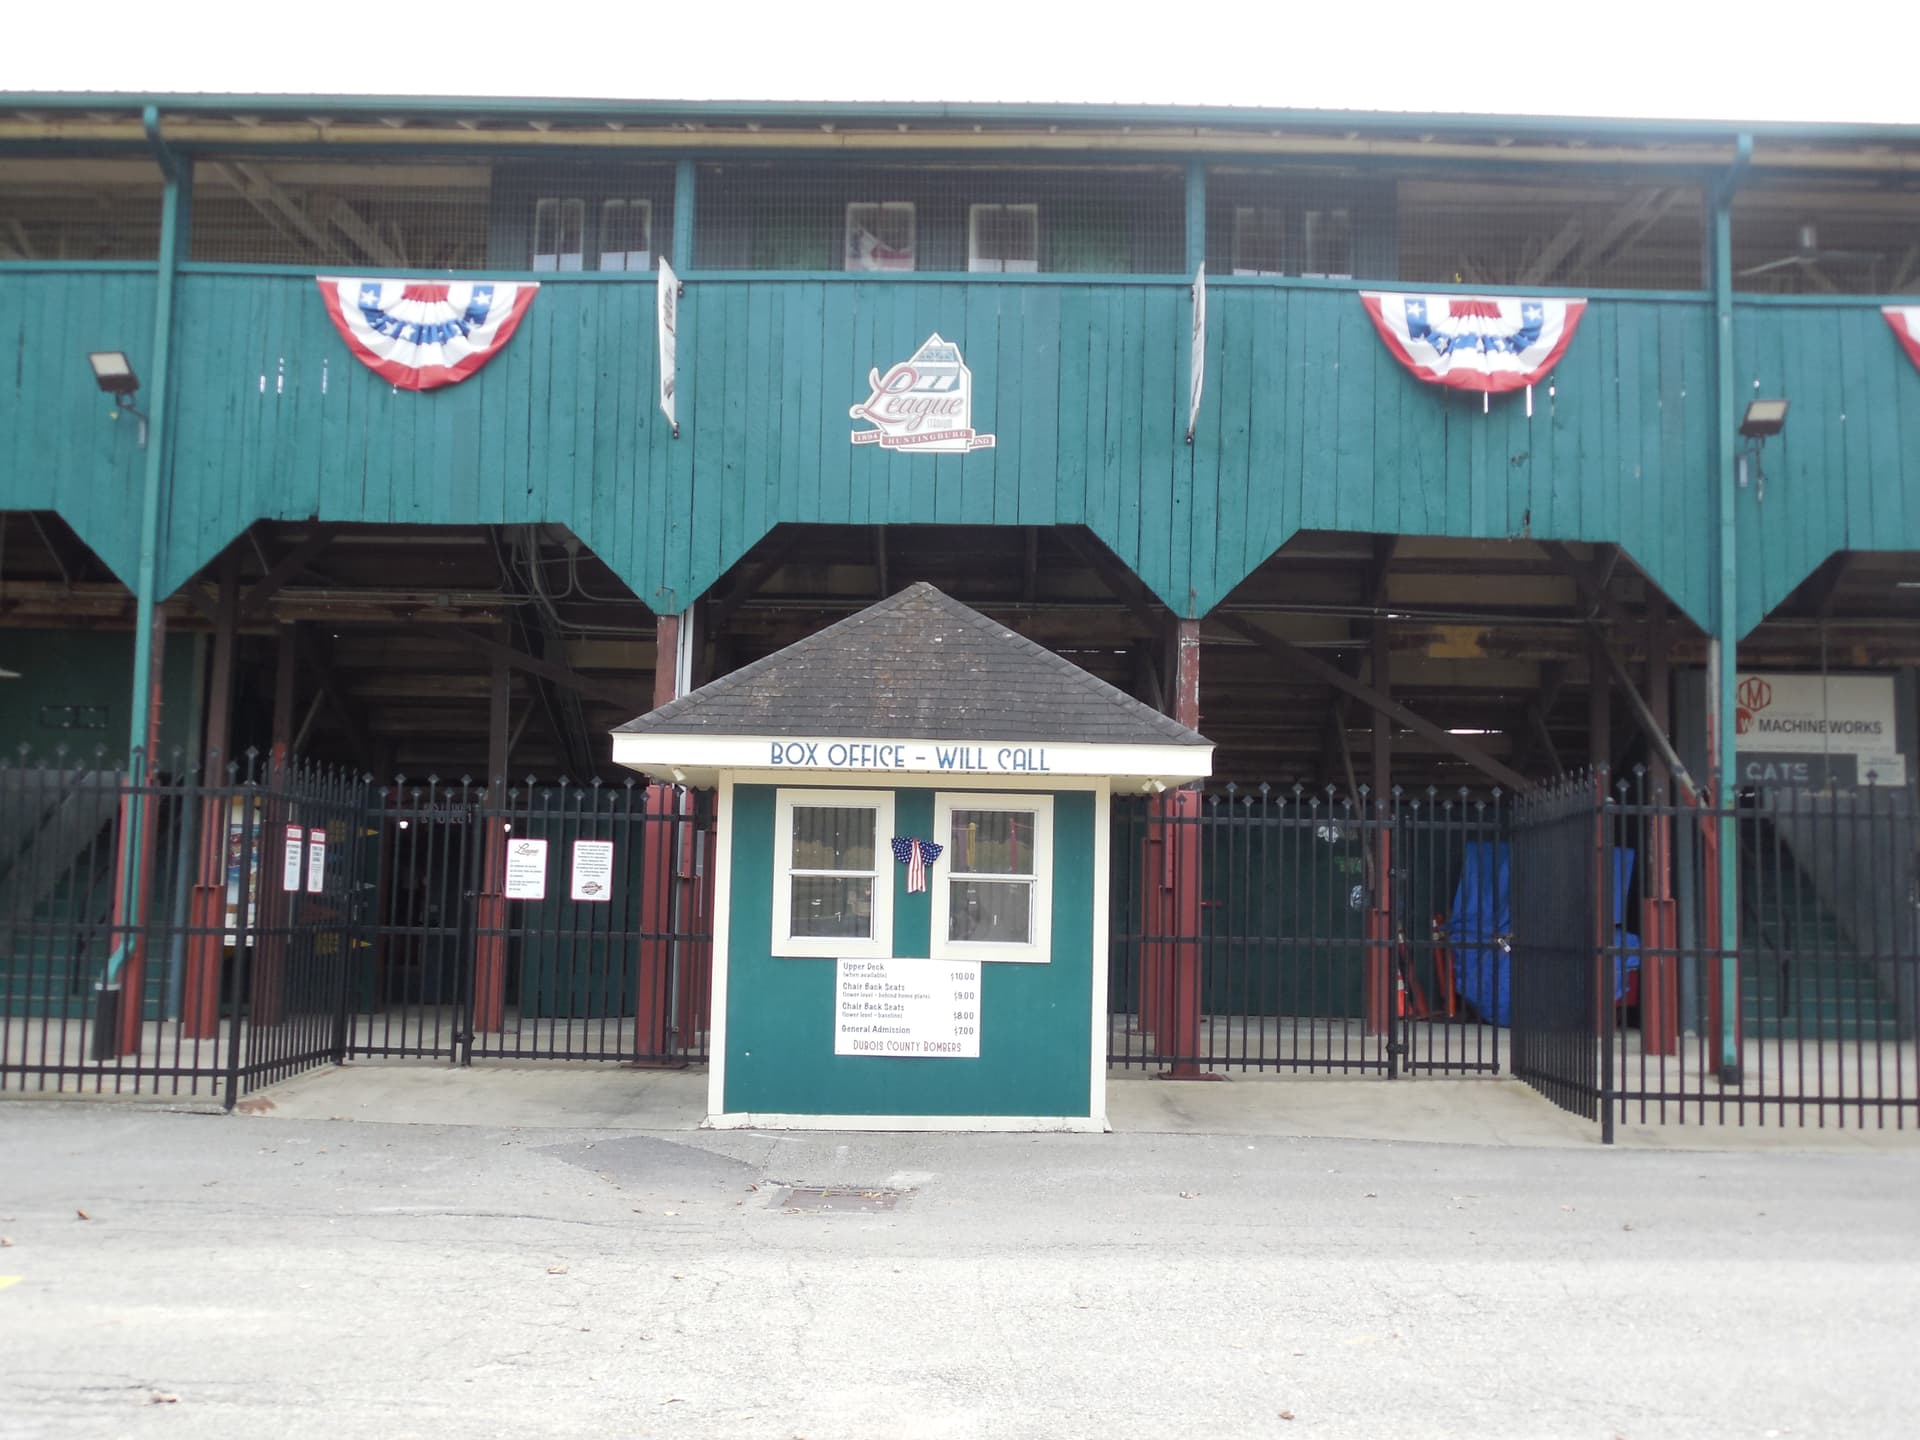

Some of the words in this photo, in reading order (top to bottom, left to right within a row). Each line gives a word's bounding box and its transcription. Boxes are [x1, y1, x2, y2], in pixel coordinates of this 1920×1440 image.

[854, 366, 963, 432] League
[886, 431, 968, 445] HUNTINGBURG
[1758, 718, 1827, 734] MACHINE
[1828, 720, 1883, 735] WORKS
[770, 741, 818, 766] BOX
[828, 743, 905, 768] OFFICE
[936, 746, 988, 769] WILL
[997, 748, 1050, 771] CALL
[843, 962, 865, 972] Upper
[867, 963, 885, 971] Deck
[842, 982, 863, 991] Chair
[864, 982, 883, 991] Back
[885, 983, 905, 992] Seats
[842, 1002, 862, 1010] Chair
[864, 1002, 883, 1011] Back
[884, 1003, 905, 1012] Seats
[841, 1024, 871, 1033] General
[872, 1025, 911, 1034] Admission
[853, 1039, 884, 1051] DUBOIS
[886, 1040, 921, 1052] COUNTY
[923, 1041, 962, 1053] BOMBERS
